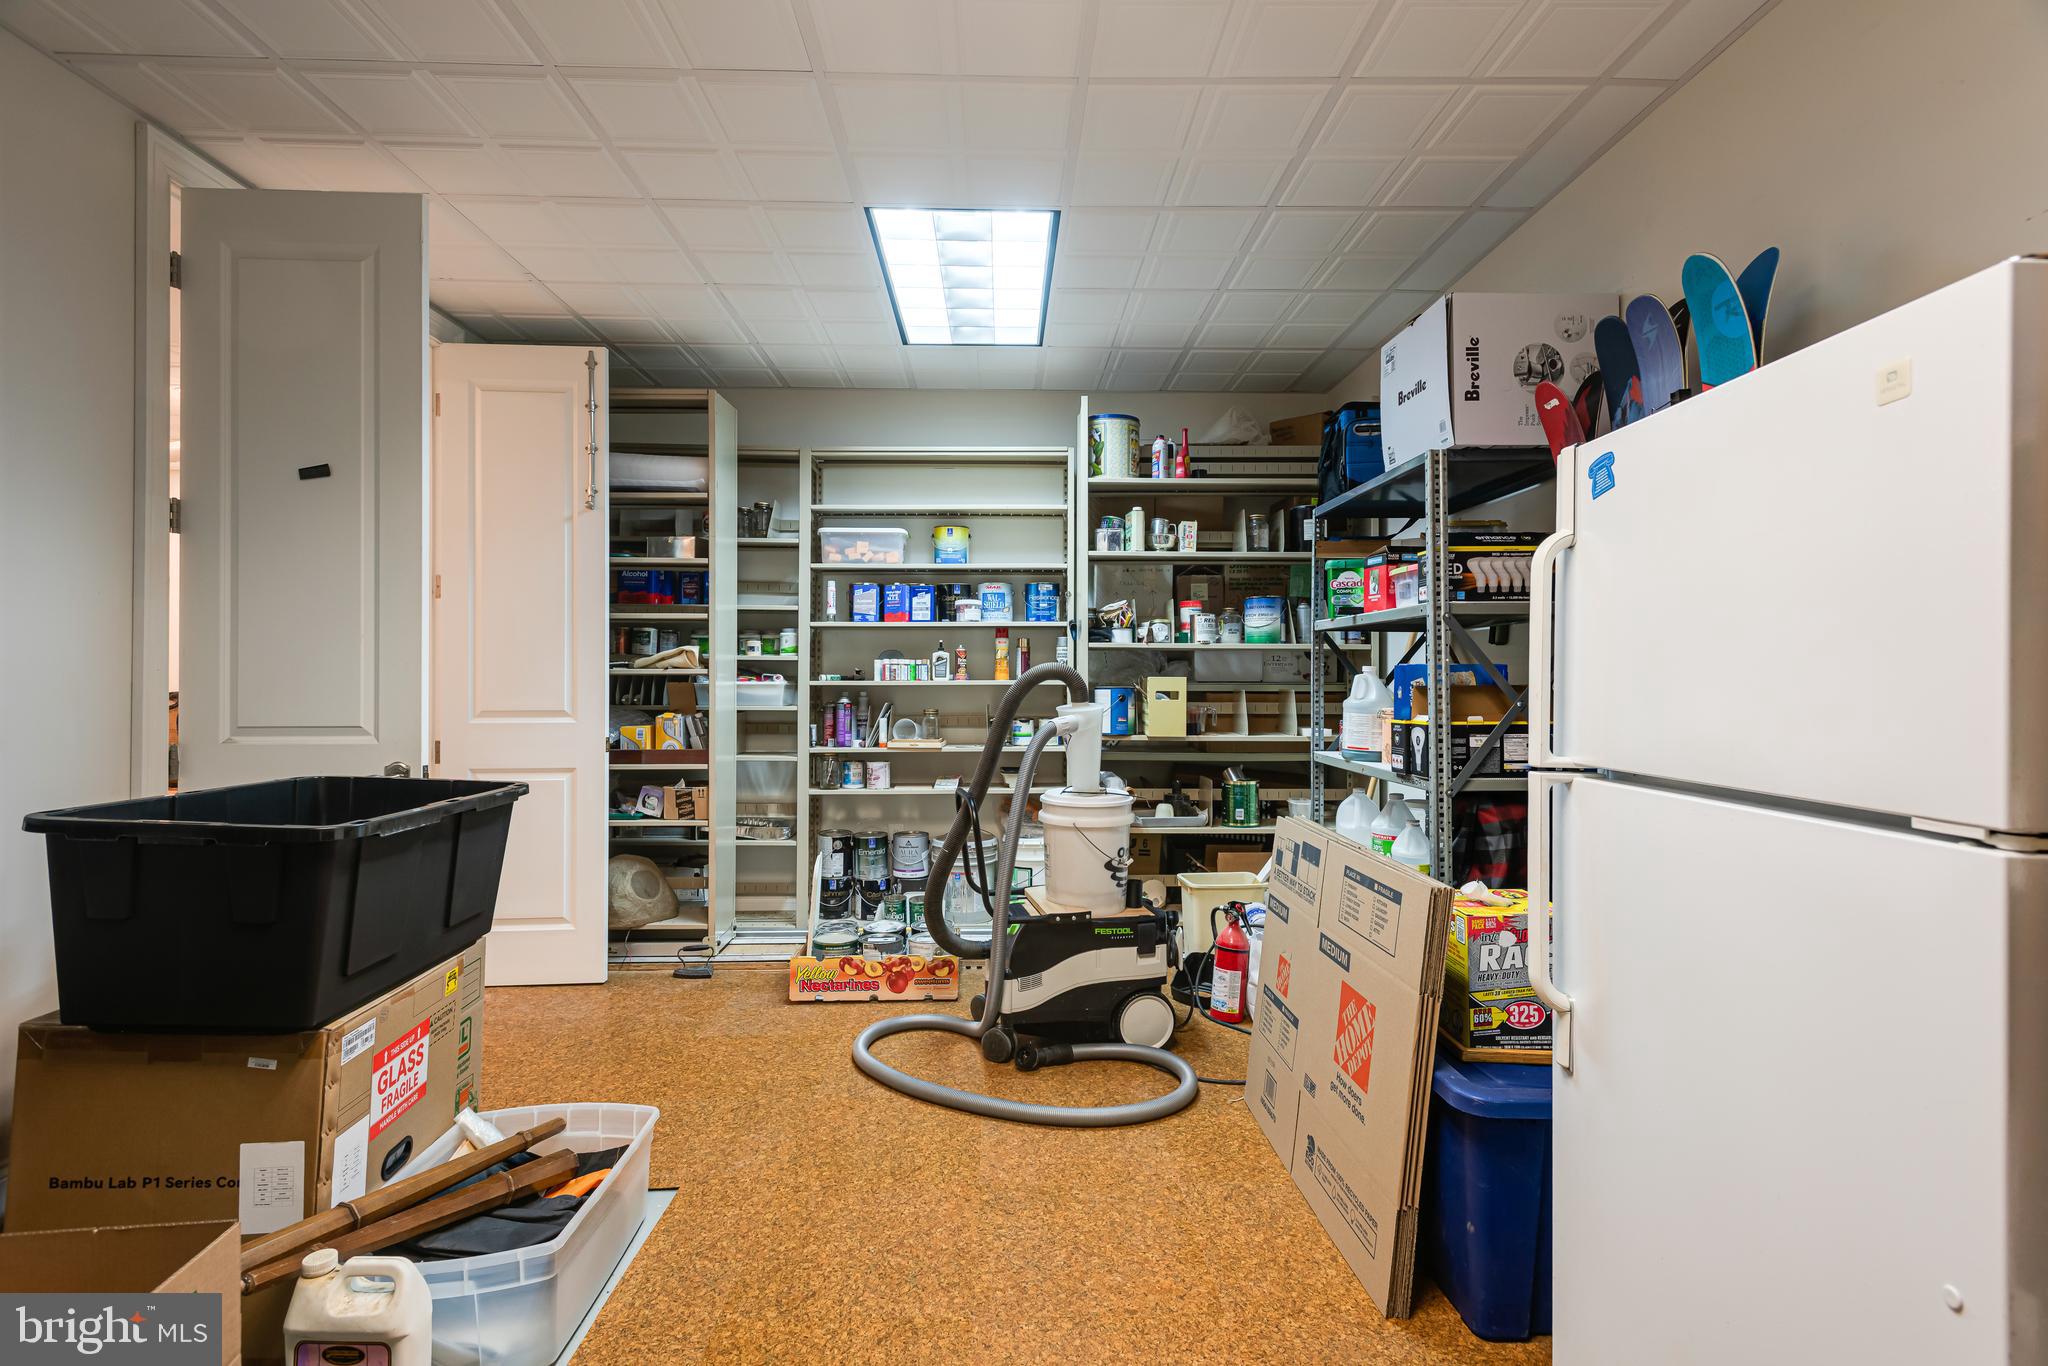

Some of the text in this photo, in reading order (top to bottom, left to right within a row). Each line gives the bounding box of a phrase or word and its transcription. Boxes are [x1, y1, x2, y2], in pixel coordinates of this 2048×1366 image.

[1464, 336, 1481, 401] Breville
[1397, 379, 1427, 406] Breville
[1448, 563, 1463, 575] ED
[1330, 578, 1364, 590] Cascad
[858, 848, 886, 856] Emerald
[1094, 927, 1134, 935] FESTOOL
[1321, 938, 1348, 967] MEDIUM
[1479, 944, 1529, 972] RA
[795, 965, 838, 984] Yellow
[799, 978, 880, 993] Nectarines
[1342, 999, 1358, 1025] THE
[1473, 1014, 1492, 1023] 60%
[1509, 1005, 1539, 1023] 325
[1335, 1001, 1375, 1067] HOME
[377, 1042, 425, 1095] GLASS
[1347, 1036, 1372, 1077] DEPOT
[381, 1071, 419, 1114] FRAGILE
[1330, 1080, 1339, 1096] get
[1338, 1089, 1352, 1109] more
[1336, 1071, 1362, 1106] How doers
[379, 1110, 397, 1130] HANDLE
[408, 1092, 419, 1106] CARE
[49, 1177, 104, 1190] Bambu
[108, 1176, 137, 1189] Lab
[142, 1177, 160, 1189] P1
[165, 1177, 212, 1189] Series
